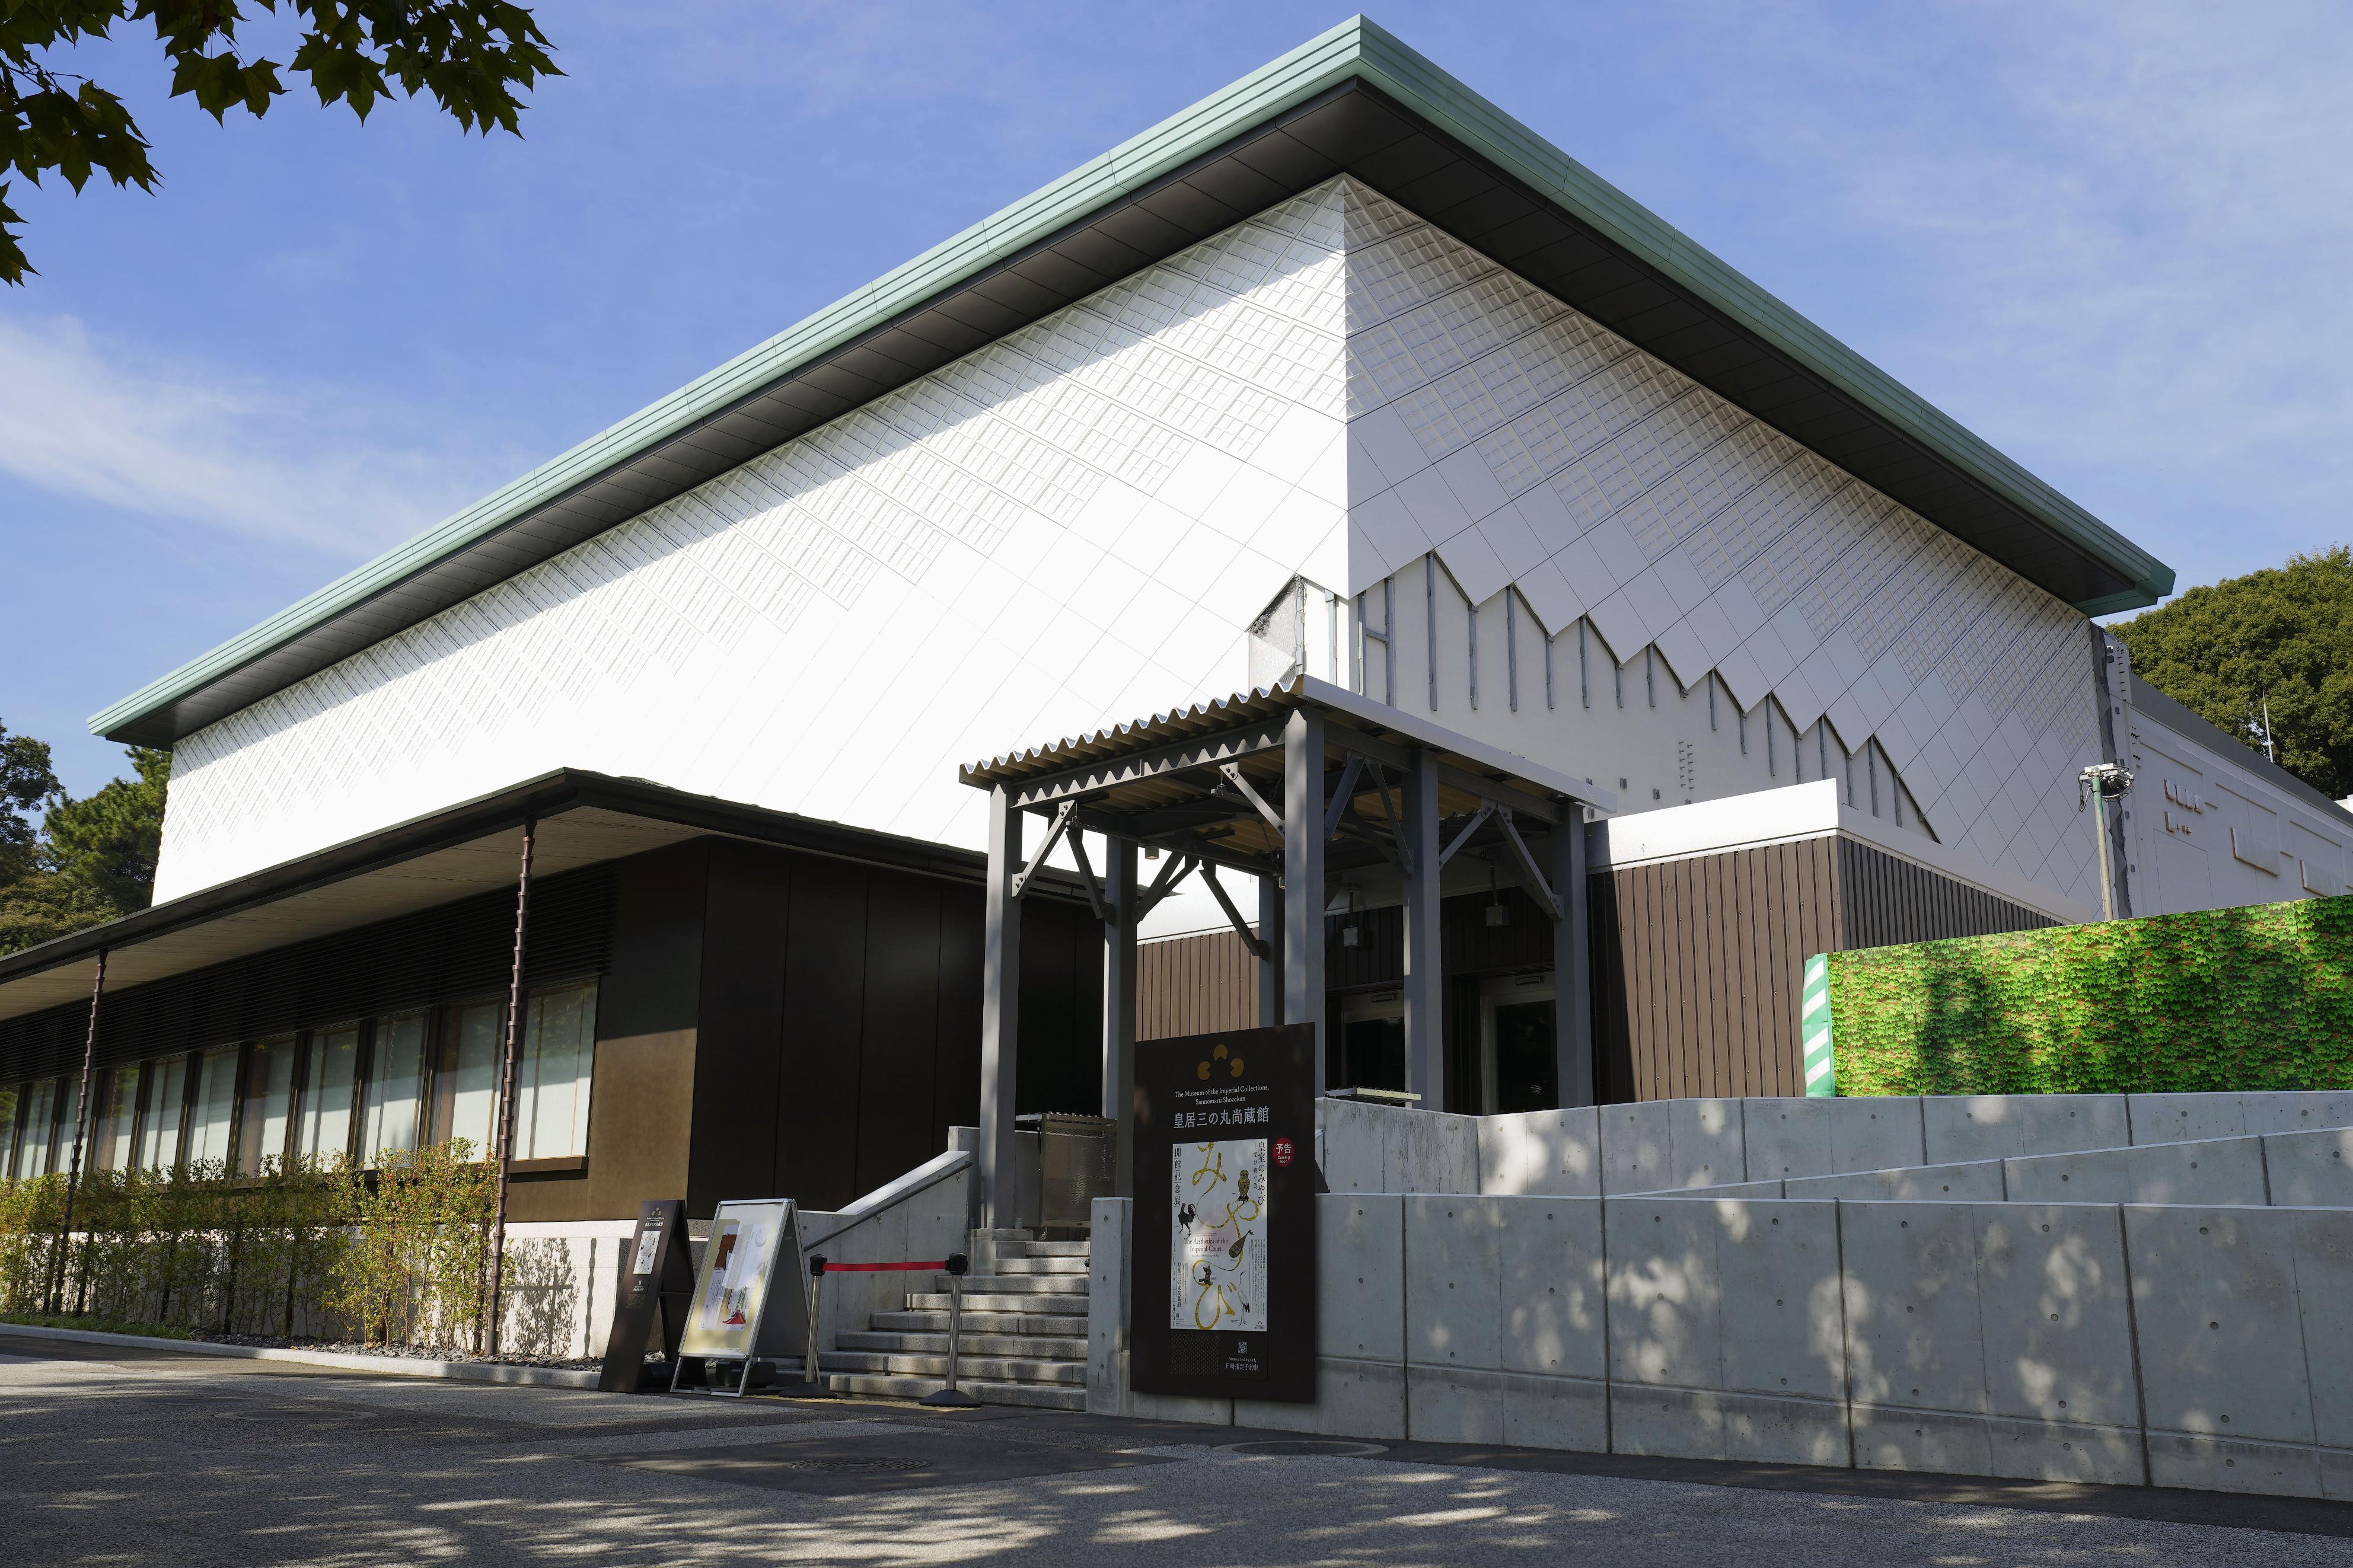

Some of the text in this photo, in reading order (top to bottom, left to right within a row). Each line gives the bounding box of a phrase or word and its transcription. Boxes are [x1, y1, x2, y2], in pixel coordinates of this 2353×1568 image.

[1219, 1086, 1239, 1095] Imperial
[1174, 1106, 1270, 1129] 皇居三の丸尚蔵館
[1276, 1143, 1292, 1154] 予告
[1258, 1141, 1266, 1205] 皇室のみやび
